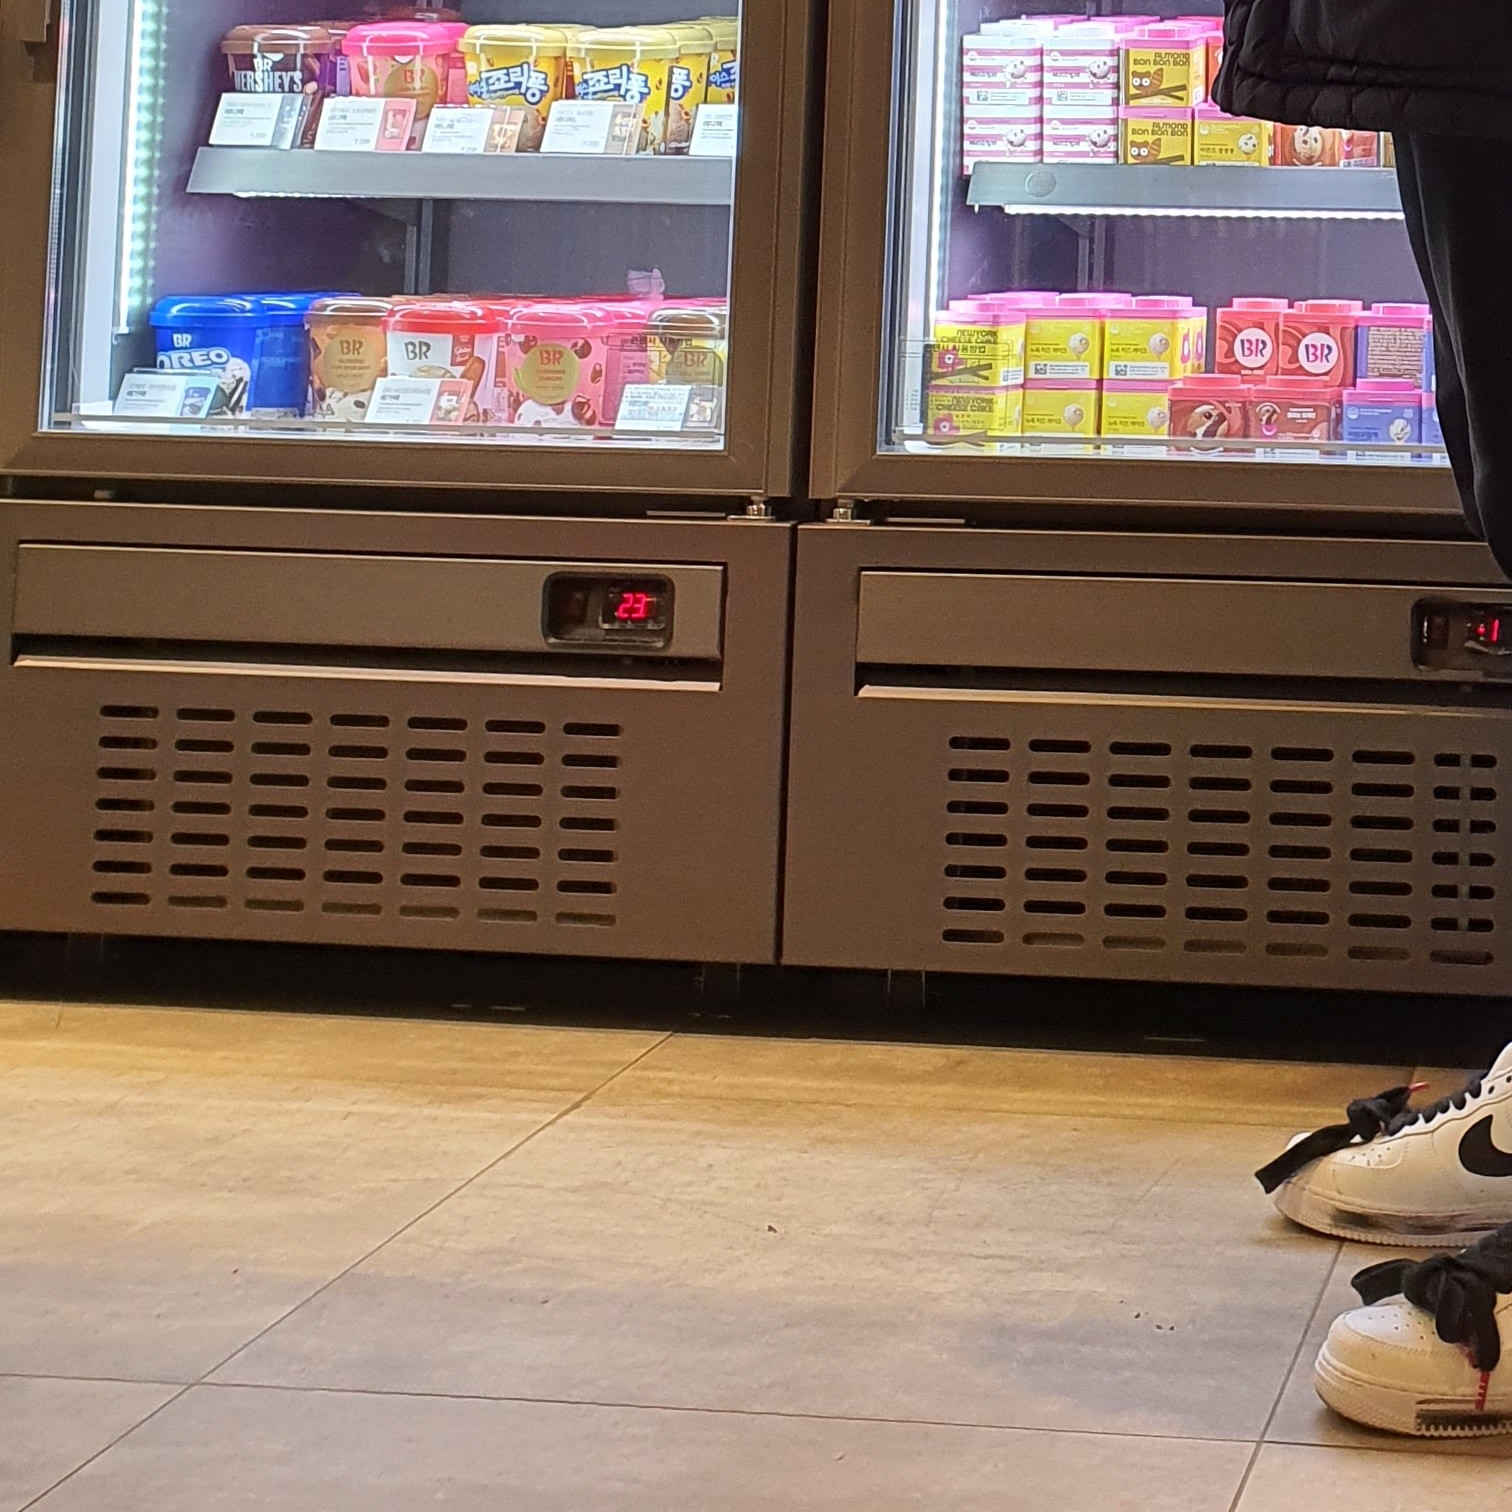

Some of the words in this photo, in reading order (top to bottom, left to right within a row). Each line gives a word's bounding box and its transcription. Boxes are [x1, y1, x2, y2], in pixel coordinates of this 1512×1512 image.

[172, 333, 192, 349] BR
[339, 339, 364, 356] BR
[404, 341, 431, 362] BR
[1240, 338, 1268, 359] BR
[157, 348, 230, 370] OREO
[539, 350, 564, 366] BR
[1304, 343, 1333, 364] BR
[617, 593, 647, 618] 23
